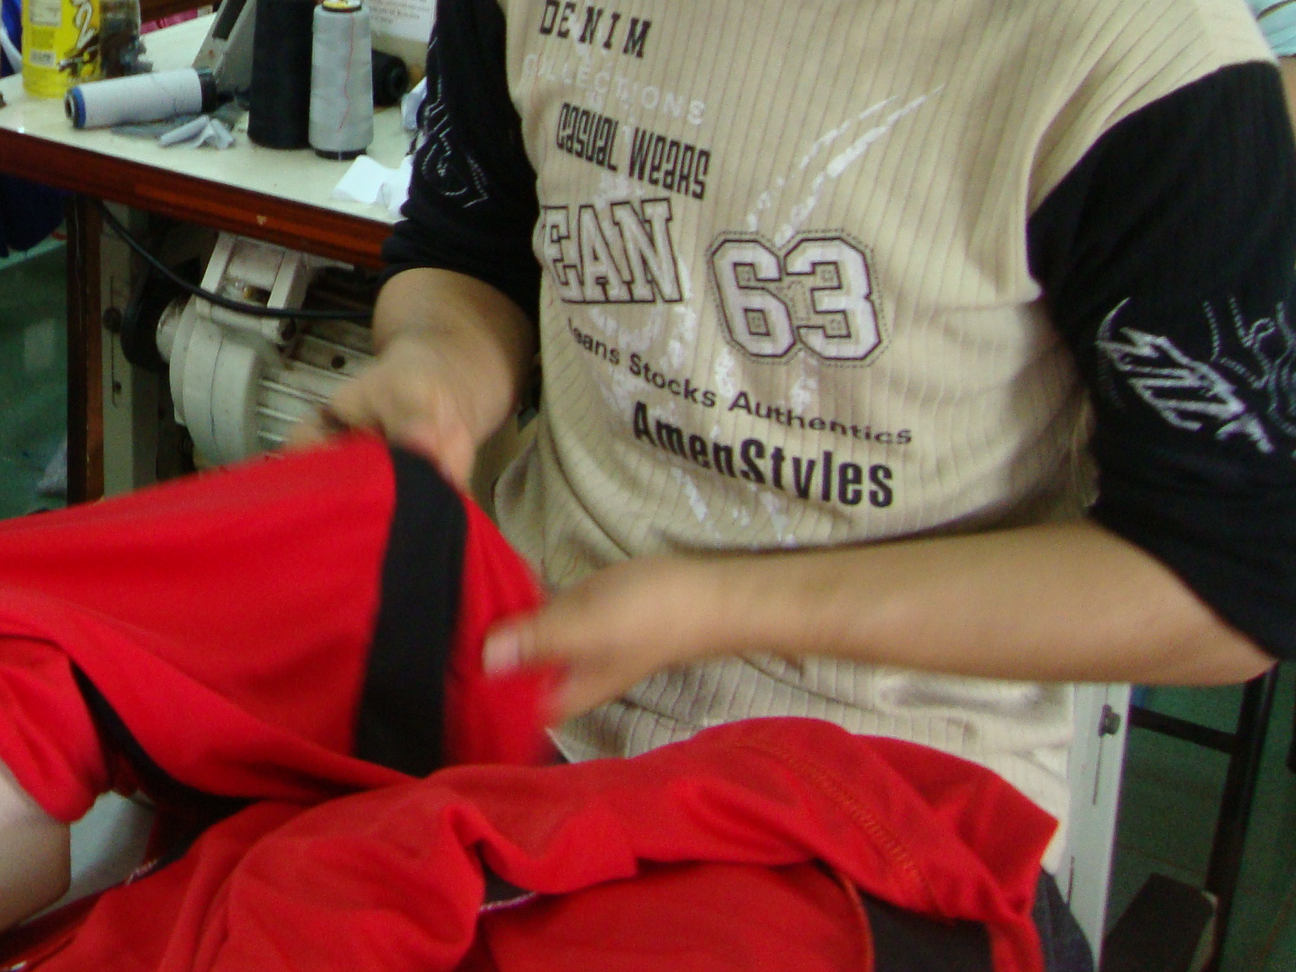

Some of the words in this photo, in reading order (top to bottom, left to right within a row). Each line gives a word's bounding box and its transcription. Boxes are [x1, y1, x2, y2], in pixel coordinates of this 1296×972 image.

[708, 231, 889, 365] 63
[629, 352, 717, 408] Stocks
[728, 390, 913, 446] Authentics
